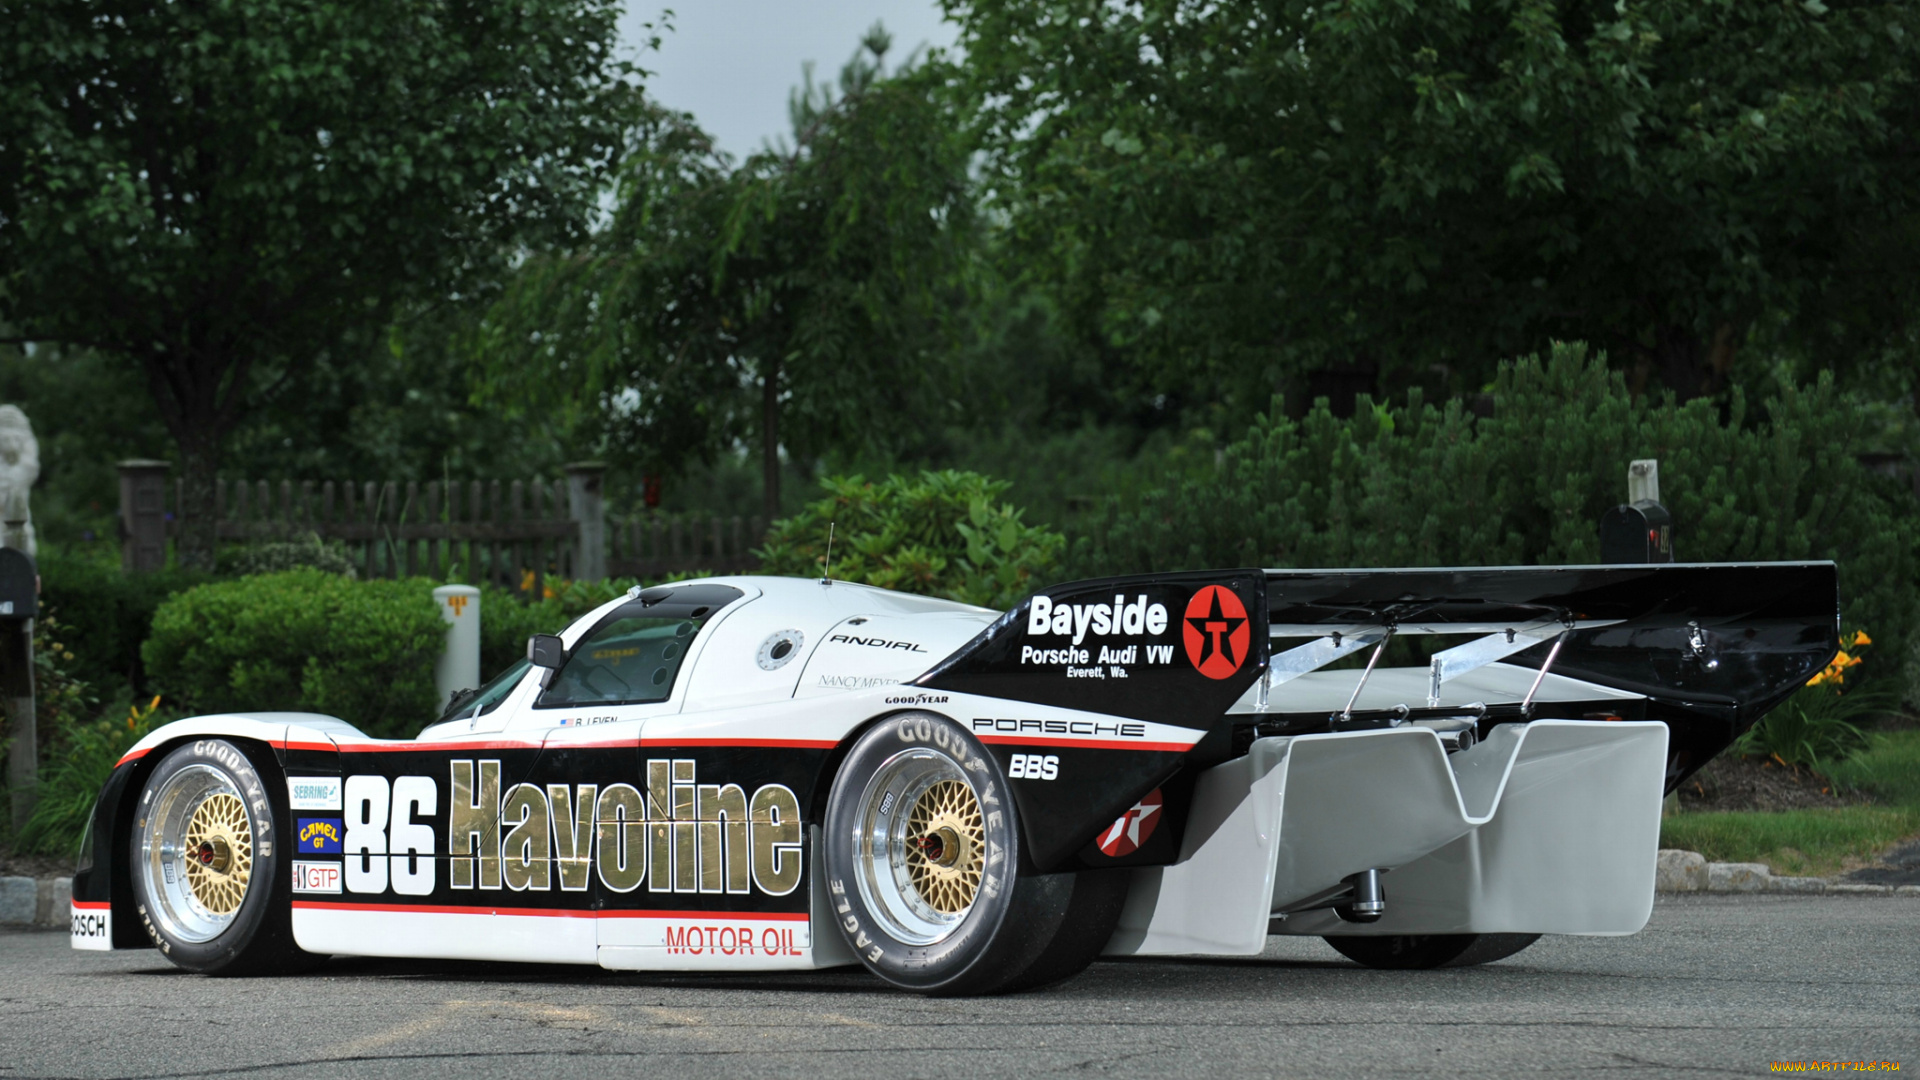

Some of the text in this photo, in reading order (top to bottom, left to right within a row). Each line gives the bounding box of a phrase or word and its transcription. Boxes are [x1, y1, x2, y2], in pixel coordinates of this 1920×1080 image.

[1027, 594, 1168, 645] Bayside
[830, 634, 927, 653] ANDIAL
[1021, 645, 1174, 664] Porsche Audi VW
[819, 674, 860, 688] NANCY
[1067, 666, 1128, 679] Everett, Wa.
[973, 718, 1145, 736] PORSCHE
[1008, 754, 1059, 781] BBS
[194, 740, 272, 857] GOODYEAR
[294, 785, 328, 799] SEBRING
[300, 822, 339, 842] CAMEL
[344, 775, 437, 896] 86
[449, 759, 802, 896] Havoline
[313, 837, 324, 848] GT
[308, 868, 338, 887] GTP
[71, 914, 105, 937] OSCH
[139, 904, 171, 953] EAGLE
[831, 879, 884, 963] EAGLE
[666, 926, 802, 956] MOTOR OIL
